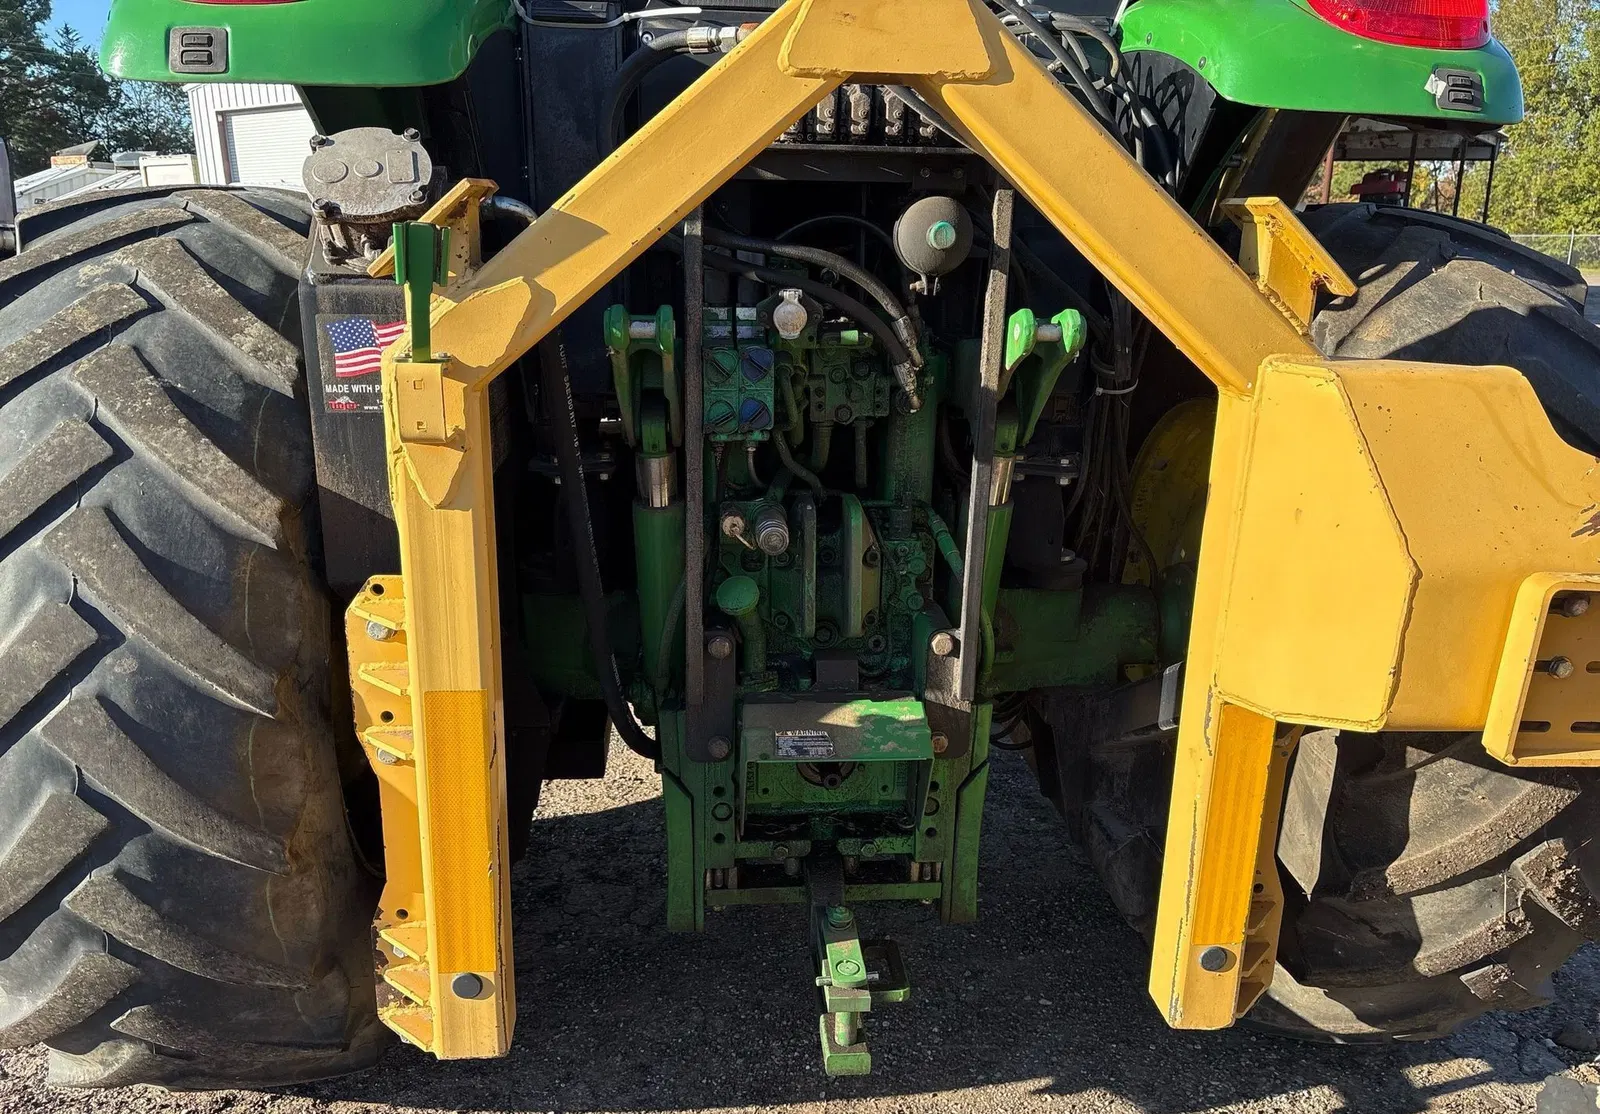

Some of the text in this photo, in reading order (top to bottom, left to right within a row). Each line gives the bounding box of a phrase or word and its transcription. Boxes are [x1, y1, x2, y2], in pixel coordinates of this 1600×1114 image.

[558, 344, 568, 369] KURT
[325, 384, 349, 393] MADE
[351, 384, 373, 393] WITH
